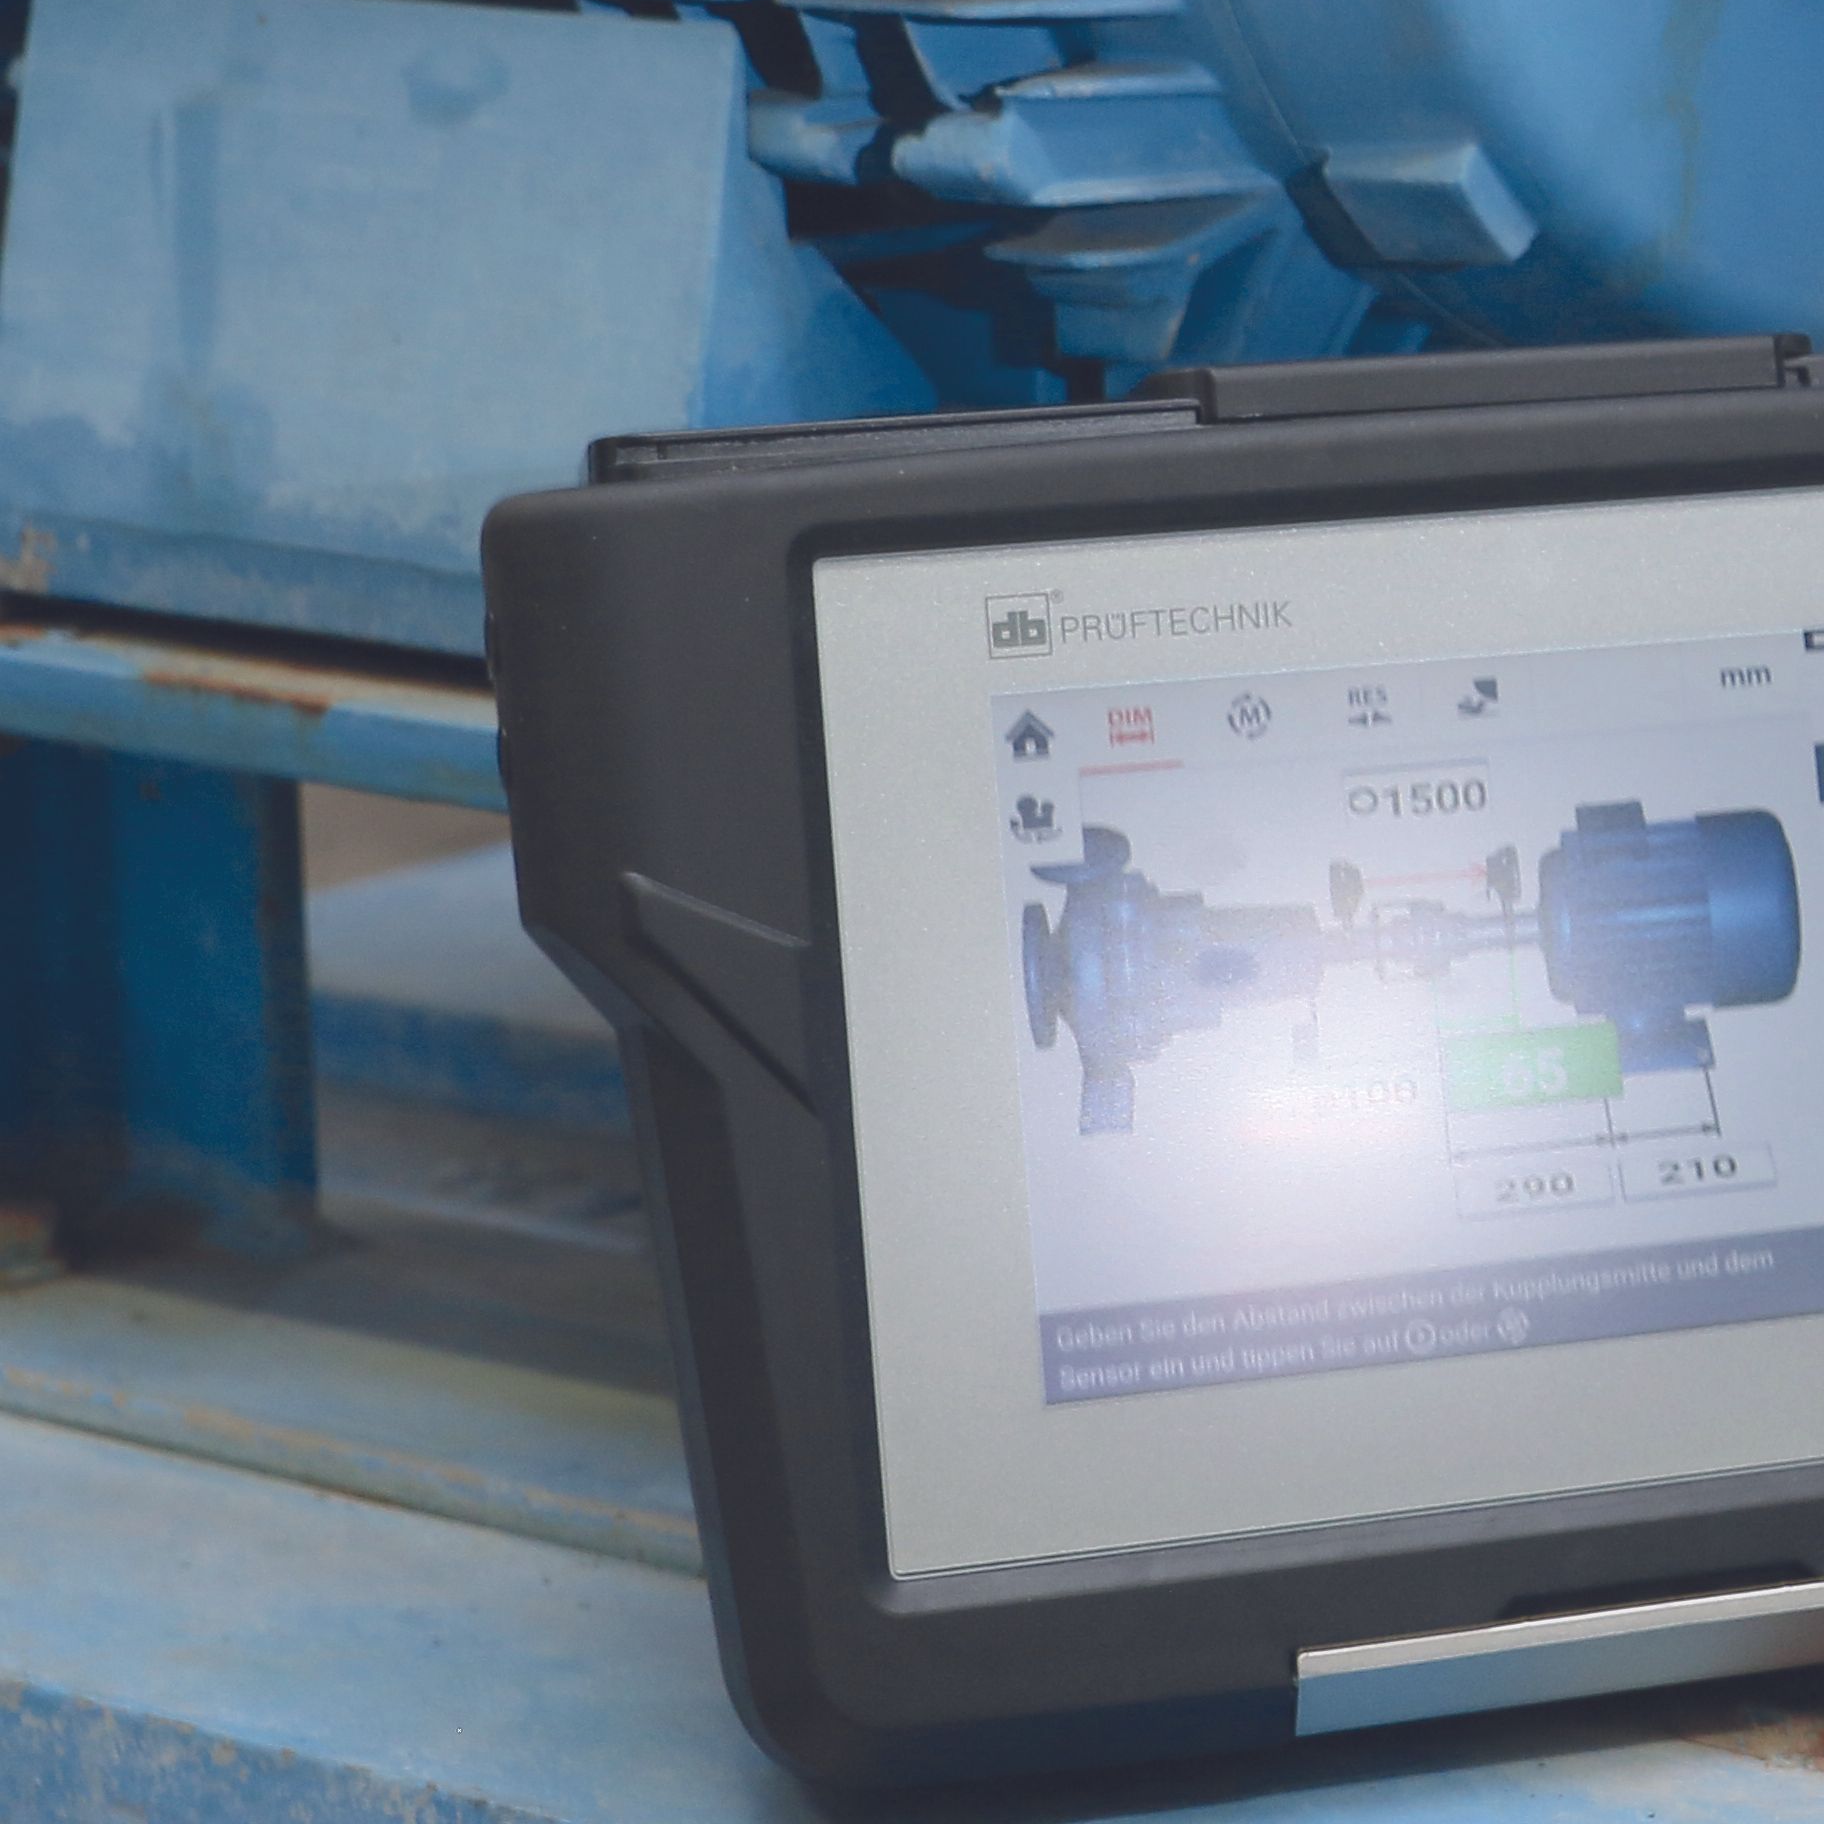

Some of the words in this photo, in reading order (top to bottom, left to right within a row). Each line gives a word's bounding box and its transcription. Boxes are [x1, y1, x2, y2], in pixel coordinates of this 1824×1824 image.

[1060, 601, 1293, 644] PRÜFTECHNIK
[1720, 664, 1772, 689] mm
[1348, 685, 1387, 706] RES
[1108, 707, 1153, 727] DIM
[1656, 1154, 1739, 1186] 210
[1055, 1322, 1133, 1353] Geben
[1140, 1316, 1176, 1340] Sie
[1181, 1309, 1227, 1336] den
[1232, 1297, 1329, 1333] Abstand
[1336, 1285, 1444, 1322] zwischen
[1451, 1278, 1490, 1304] der
[1493, 1261, 1672, 1302] Kupplungsmitte
[1676, 1251, 1719, 1277] und
[1723, 1248, 1775, 1274] dem
[1059, 1362, 1142, 1392] Sensor
[1149, 1355, 1185, 1379] ein
[1191, 1348, 1235, 1375] und
[1241, 1340, 1316, 1374] tippen
[1322, 1333, 1356, 1360] Sie
[1363, 1327, 1401, 1353] auf
[1440, 1317, 1492, 1346] oder
